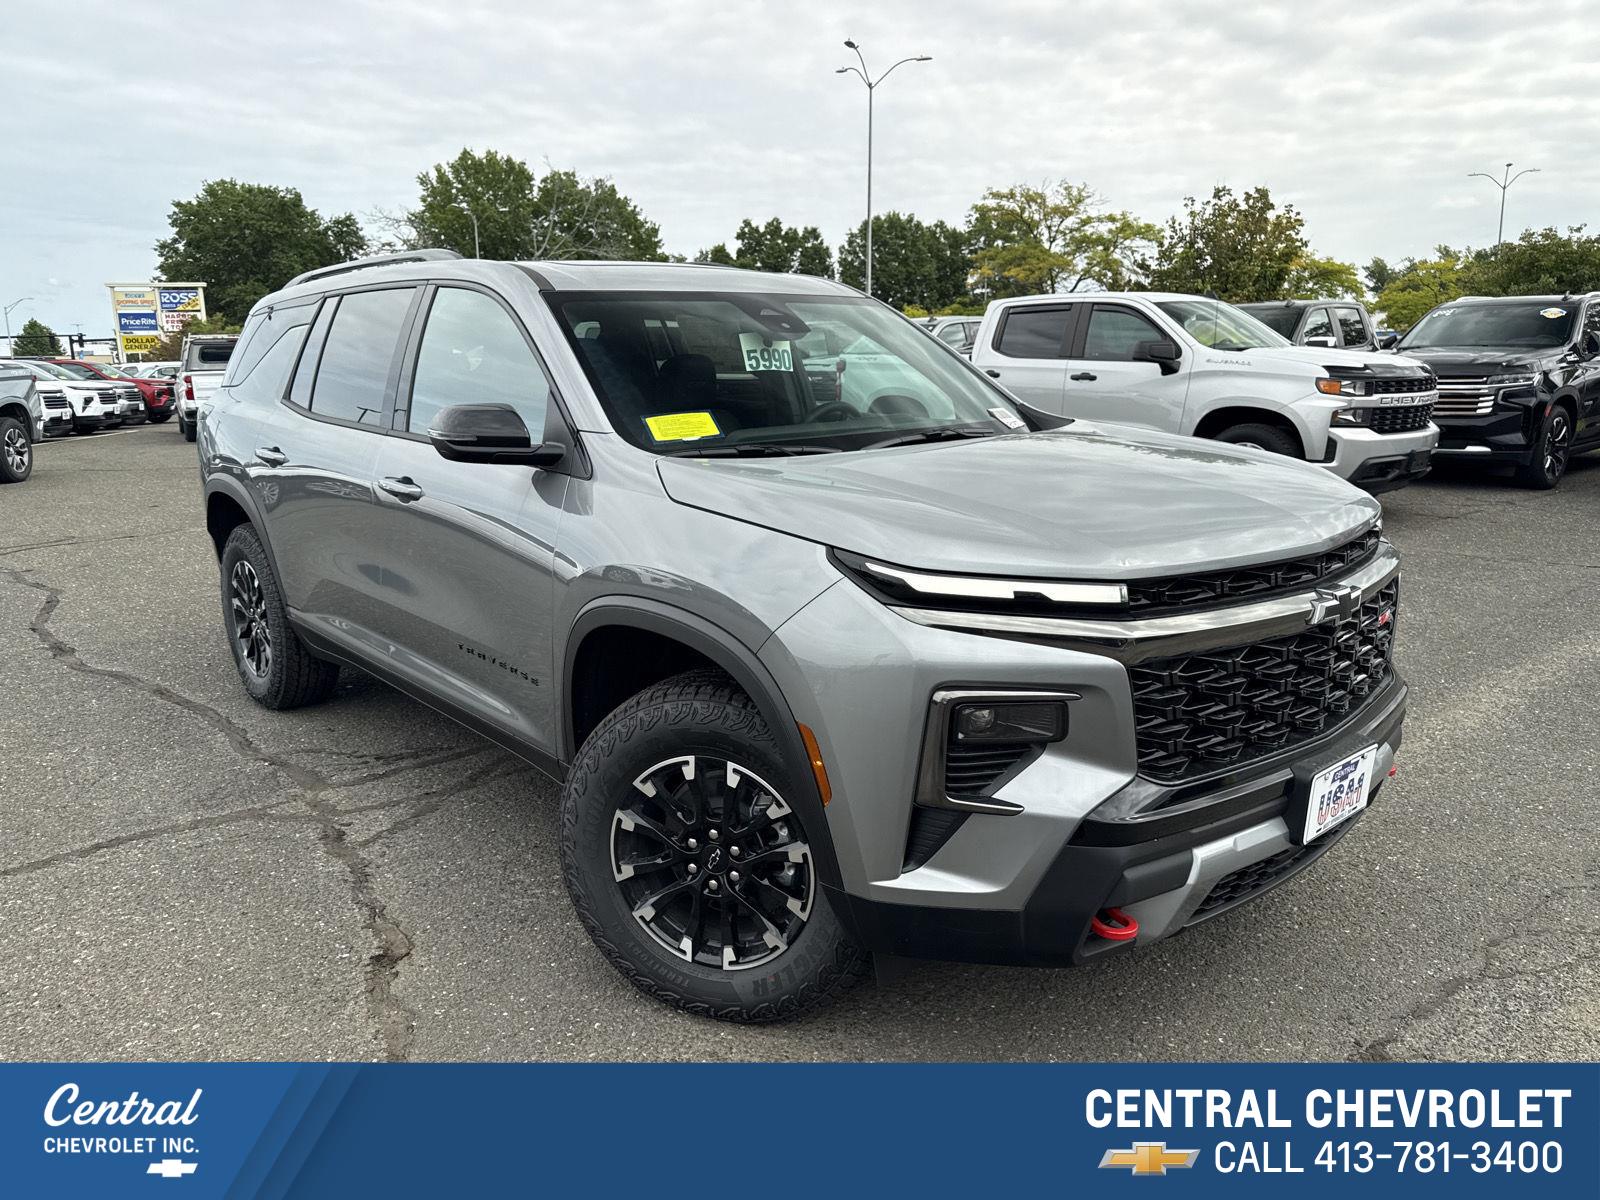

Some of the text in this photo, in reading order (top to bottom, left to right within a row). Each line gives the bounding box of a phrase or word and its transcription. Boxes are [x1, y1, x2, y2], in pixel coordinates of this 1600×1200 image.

[161, 292, 197, 303] ROSS
[121, 317, 156, 325] Price Rite
[746, 347, 792, 370] 5990
[456, 641, 540, 687] TRAVERSE
